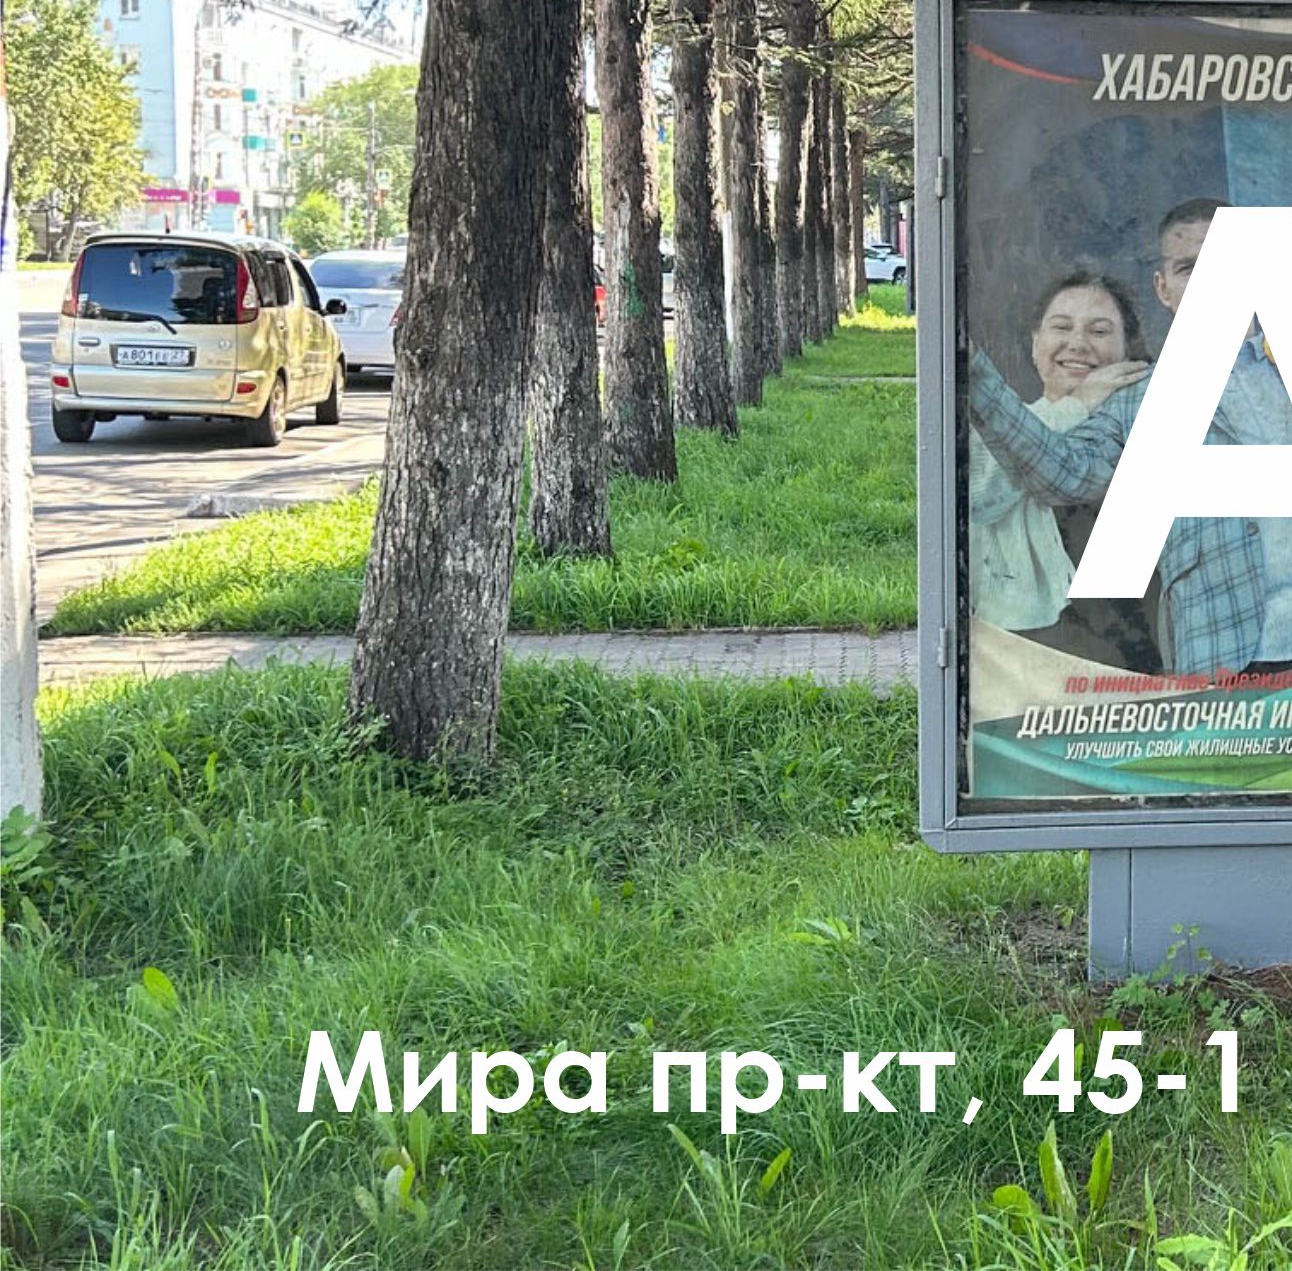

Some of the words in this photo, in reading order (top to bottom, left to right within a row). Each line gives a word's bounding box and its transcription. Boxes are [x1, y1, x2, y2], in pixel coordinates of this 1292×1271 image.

[1064, 676, 1089, 694] по
[1092, 673, 1210, 695] инициативе
[1016, 698, 1266, 739] ДАЛЬНЕВОСТОЧНАЯ
[1064, 740, 1142, 760] УЛУЧШИТЬ
[1146, 739, 1182, 758] СВОИ
[1184, 736, 1276, 757] ЖИЛИЩНЫЕ
